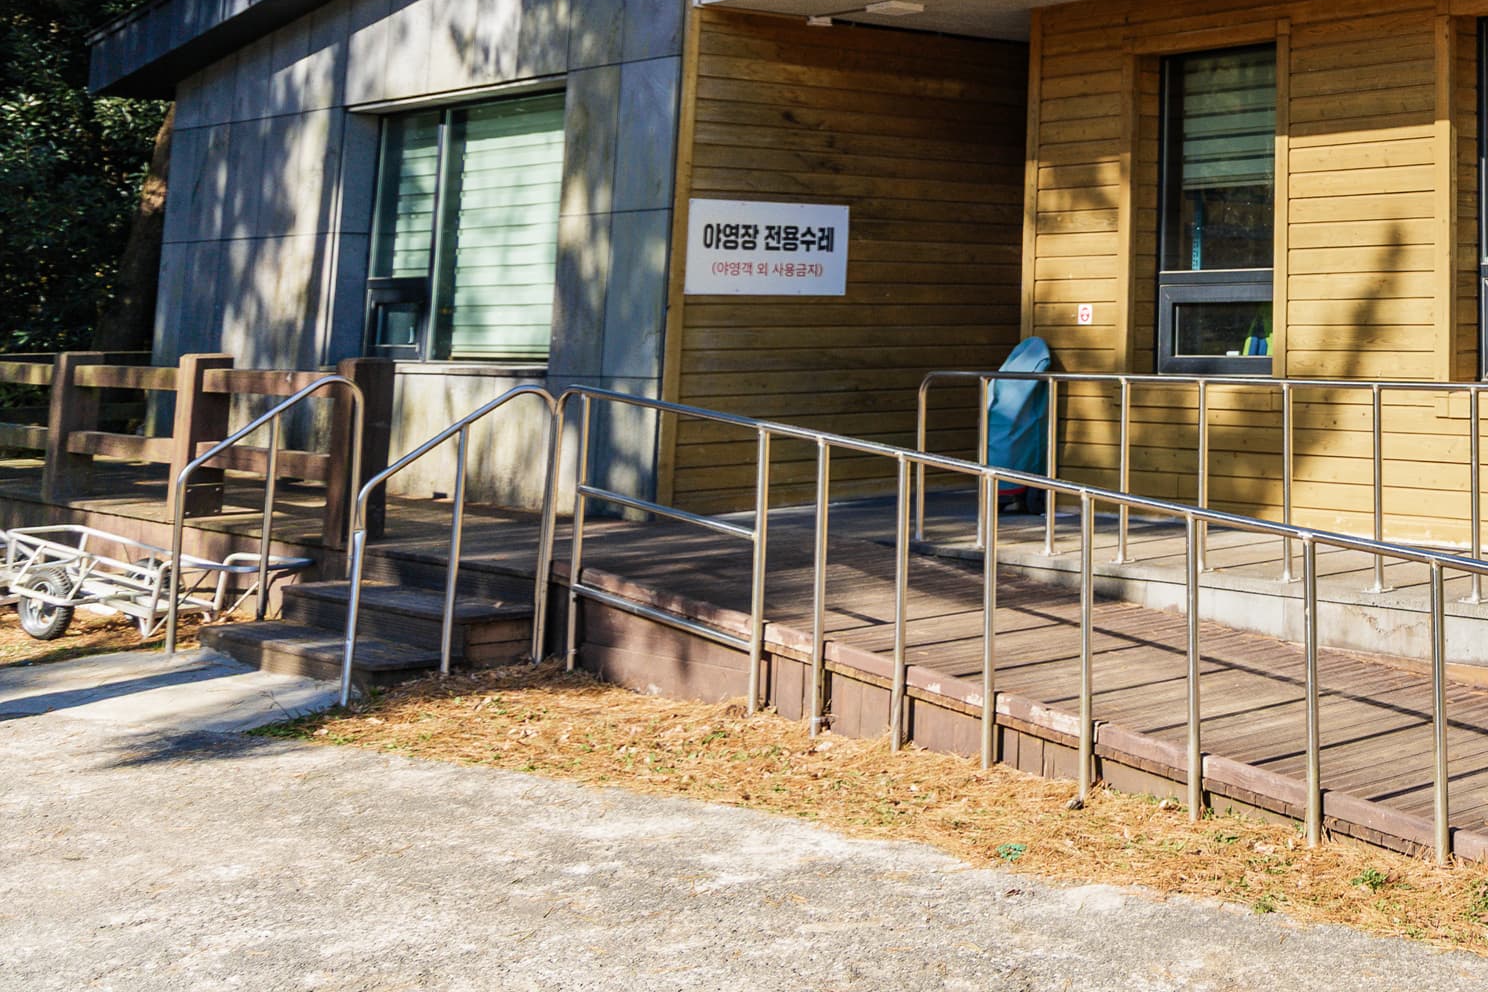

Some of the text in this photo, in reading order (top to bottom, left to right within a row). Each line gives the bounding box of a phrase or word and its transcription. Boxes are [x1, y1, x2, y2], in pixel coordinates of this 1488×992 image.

[703, 223, 835, 253] 야영장 전용수레
[712, 262, 823, 278] (야영객 외 사용금지)
